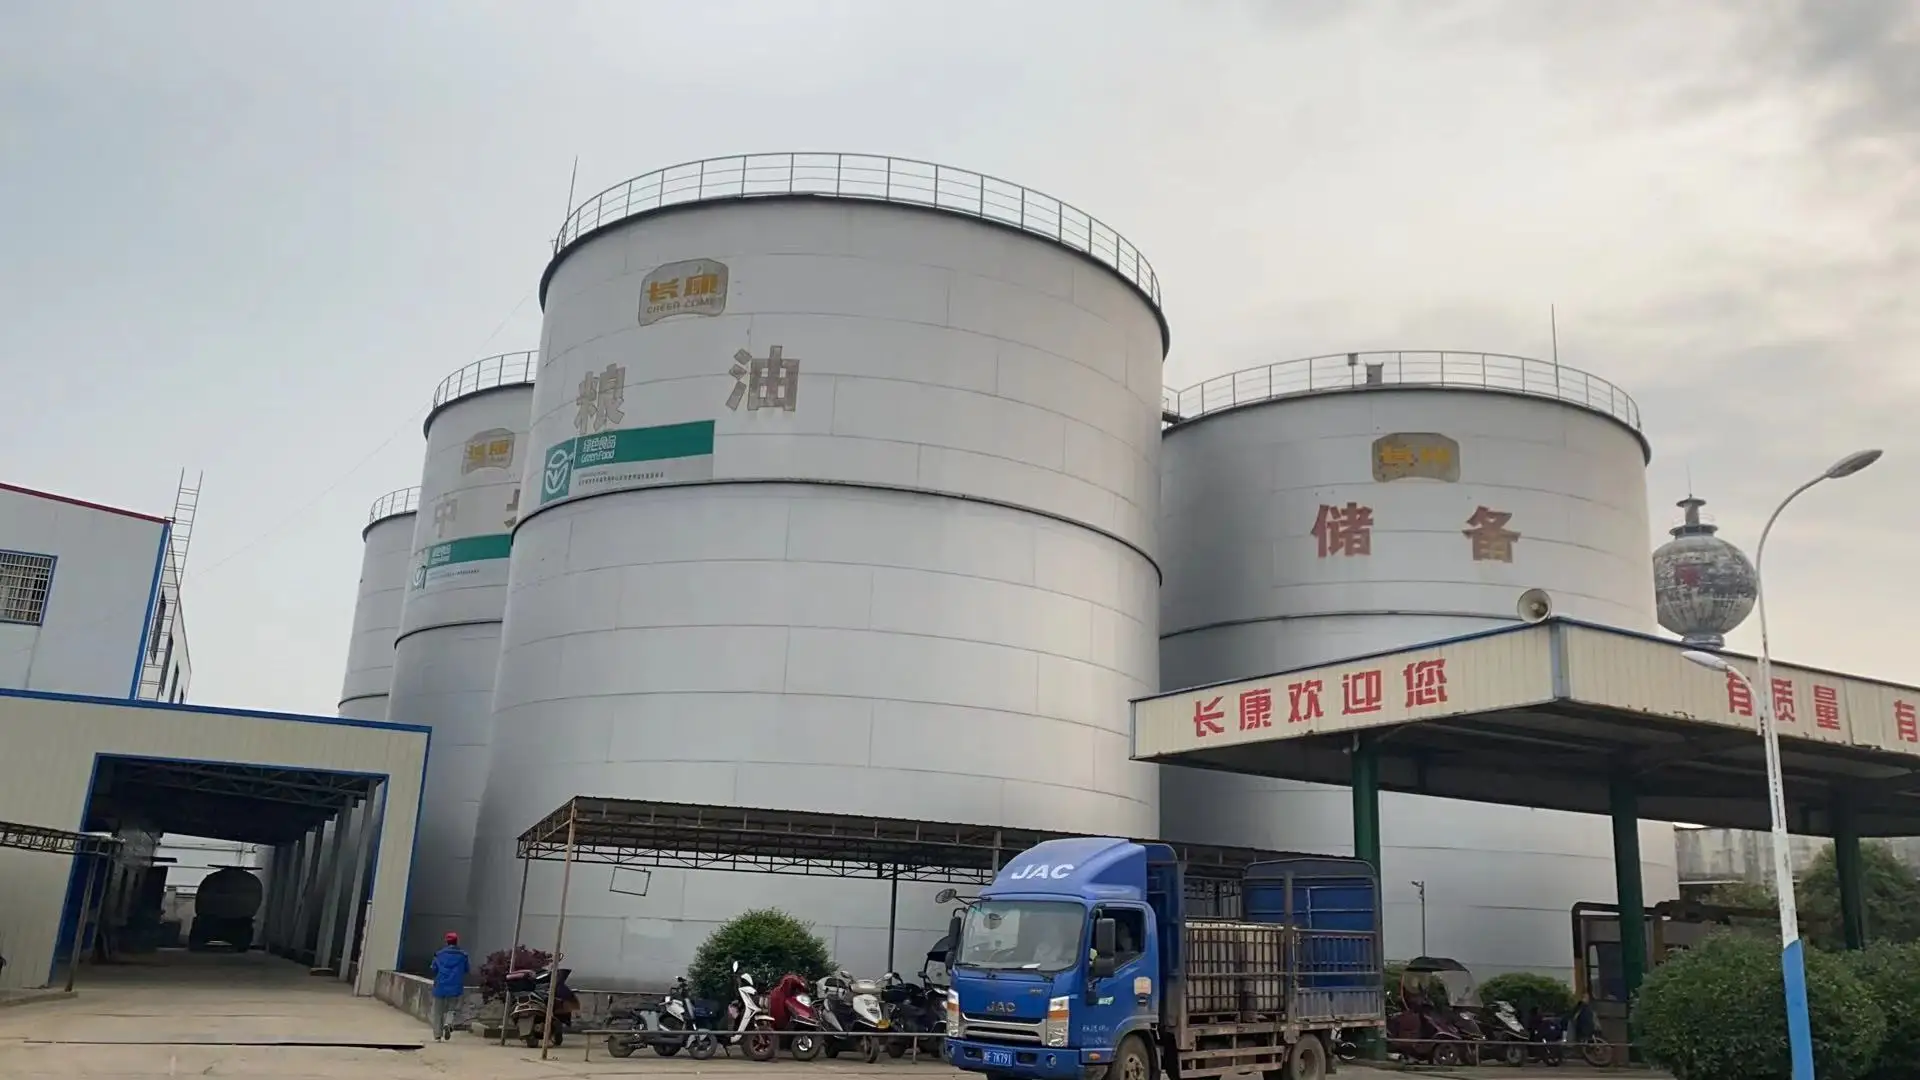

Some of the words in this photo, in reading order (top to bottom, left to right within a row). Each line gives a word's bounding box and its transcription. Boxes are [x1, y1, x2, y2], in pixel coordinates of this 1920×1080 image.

[1311, 502, 1521, 563] 储备
[1193, 658, 1448, 737] 长康欢迎您
[1011, 864, 1074, 879] JAC
[986, 1001, 1016, 1013] JAC
